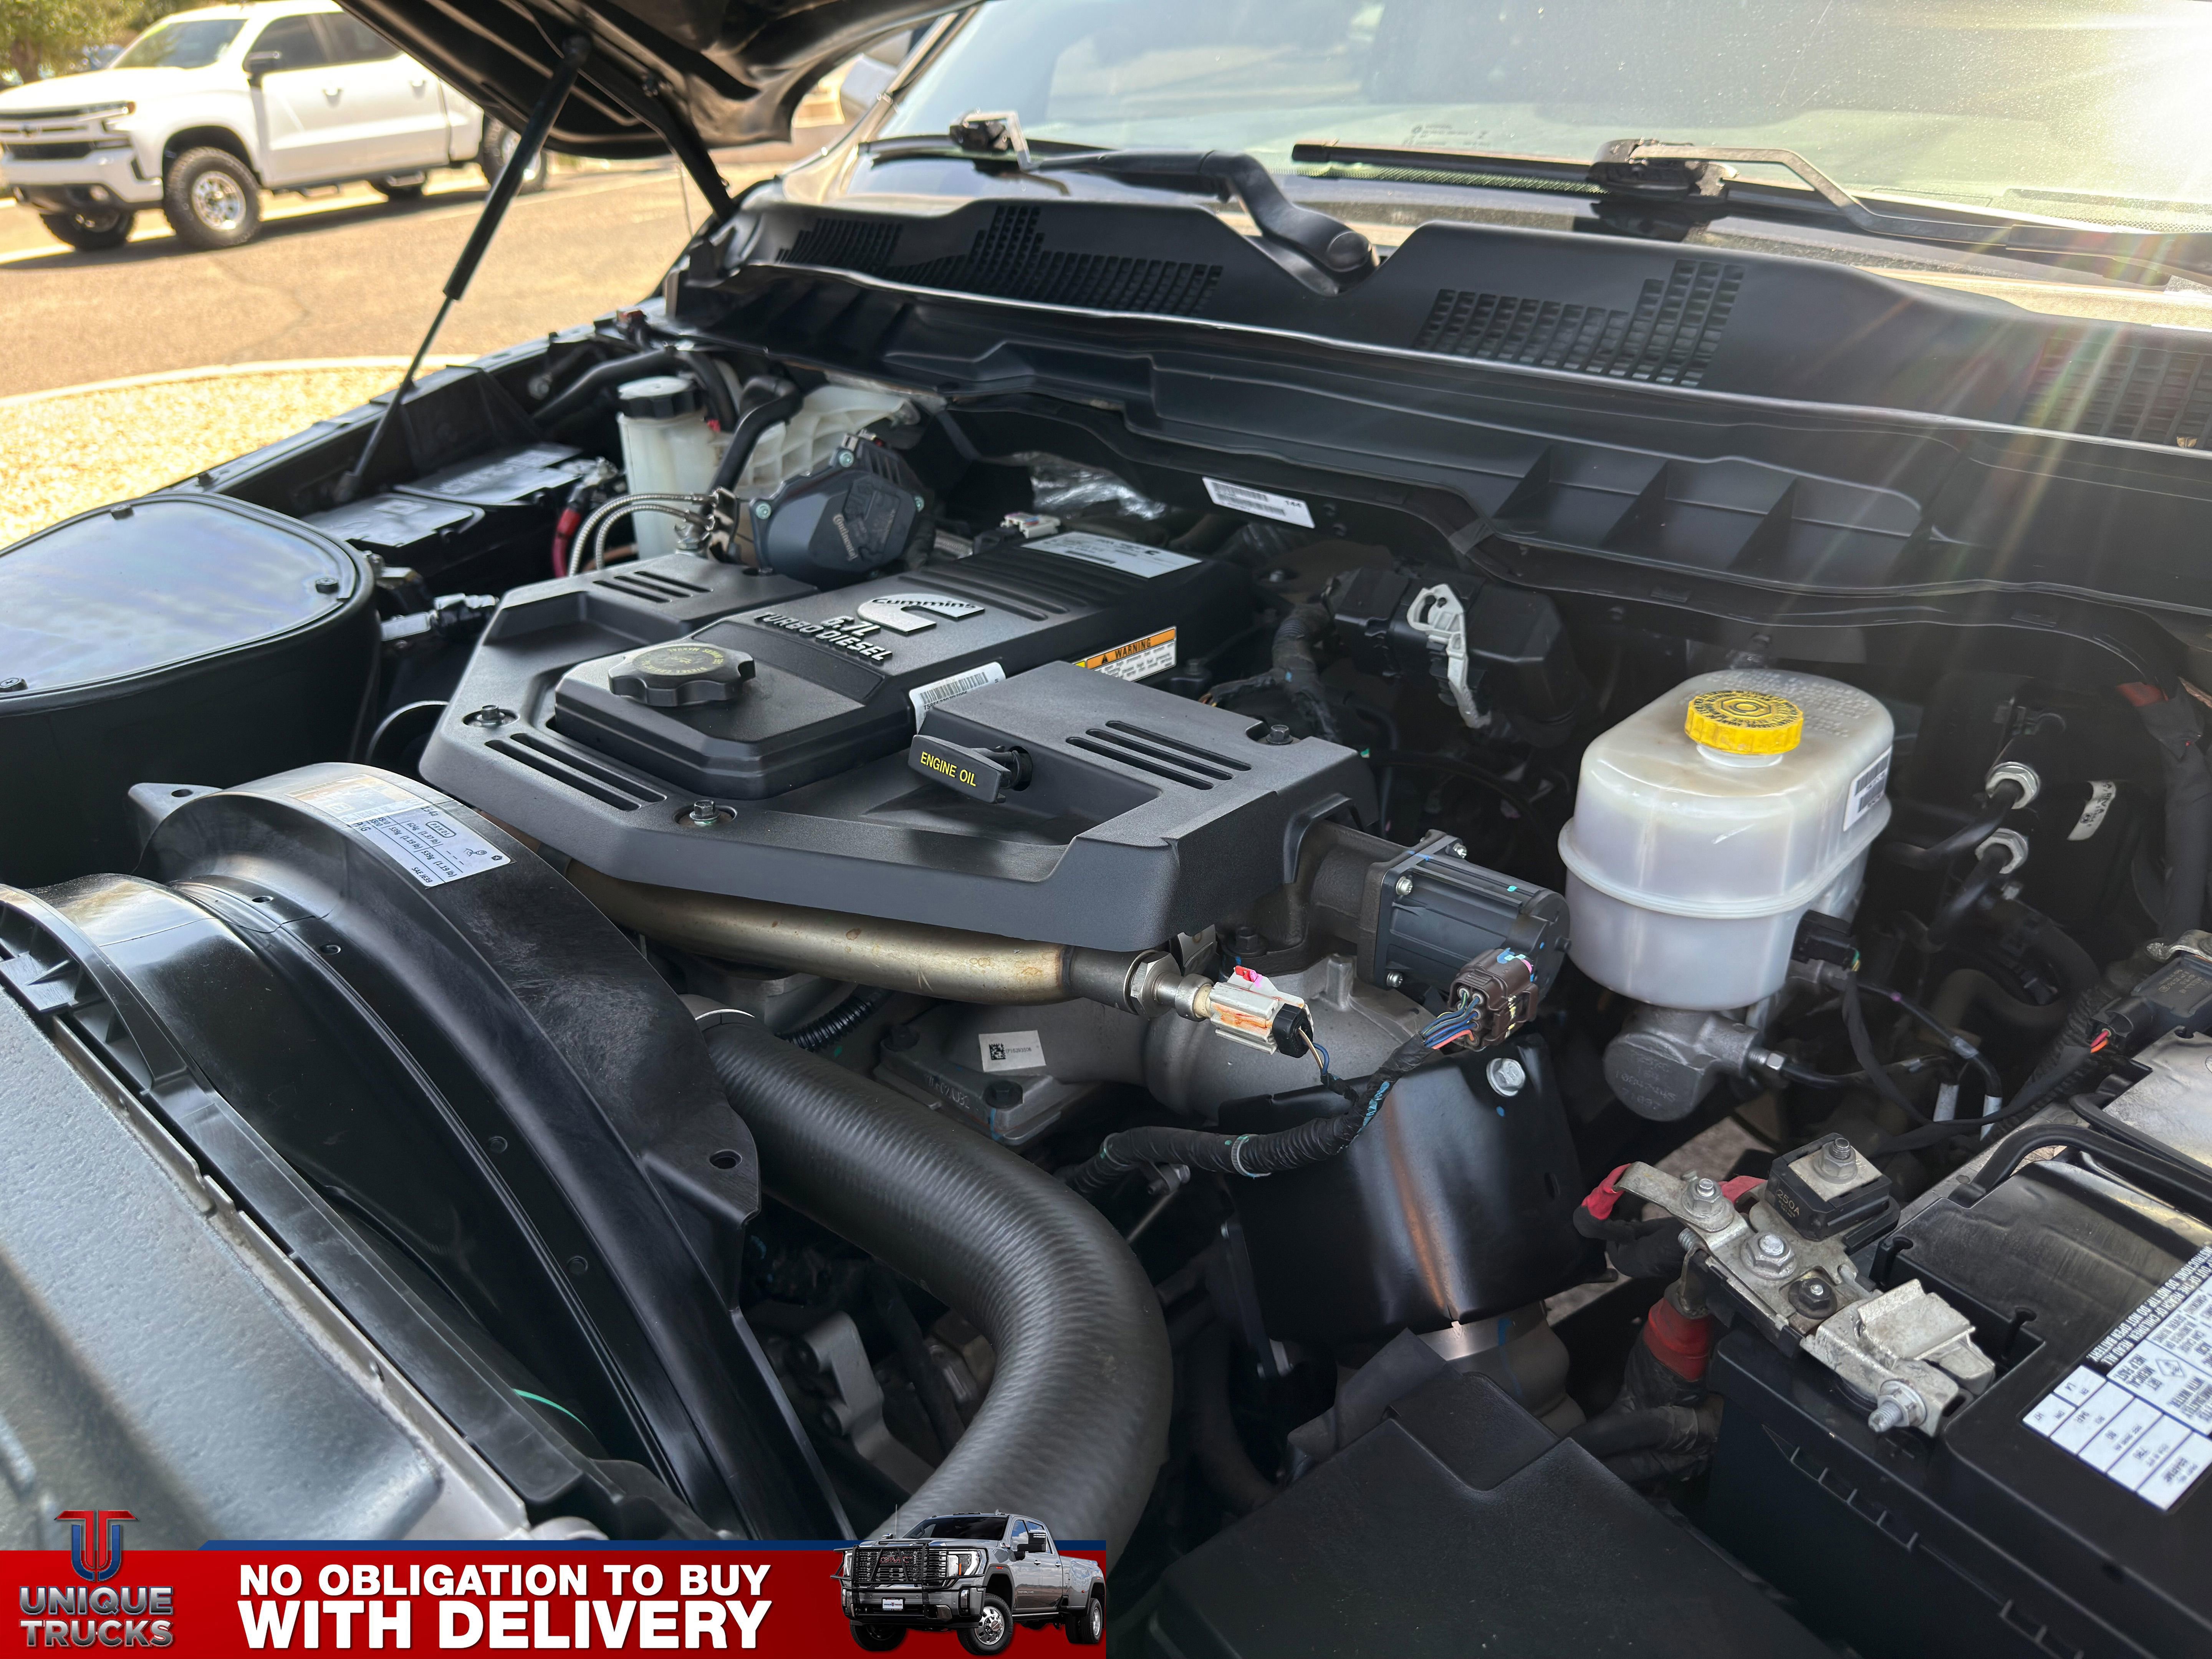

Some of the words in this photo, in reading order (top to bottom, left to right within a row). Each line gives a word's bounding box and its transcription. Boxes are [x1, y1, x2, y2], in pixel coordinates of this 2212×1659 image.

[832, 513, 859, 561] Continental
[821, 616, 881, 636] 6.7L
[754, 612, 825, 635] TURBO
[815, 629, 893, 661] DIESEL
[1115, 638, 1152, 659] WARNING
[921, 751, 957, 778] ENGINE
[959, 769, 977, 787] OIL
[430, 823, 450, 836] PRNDL
[421, 850, 435, 860] 539g
[412, 867, 422, 875] SAE
[1777, 1189, 1799, 1216] 250A
[2164, 1278, 2180, 1290] DO
[2177, 1282, 2194, 1295] THE
[2189, 1275, 2202, 1286] OF
[2154, 1286, 2172, 1300] NOT
[2162, 1291, 2185, 1310] REACH
[2136, 1305, 2152, 1315] DO
[2154, 1306, 2168, 1318] OF
[2125, 1312, 2143, 1327] NOT
[2126, 1313, 2161, 1342] CHILDREN.
[2110, 1323, 2133, 1341] OPEN
[2112, 1339, 2134, 1357] READ
[2100, 1352, 2119, 1365] ALL
[2128, 1354, 2147, 1370] HELP
[2113, 1365, 2135, 1382] FAST.
[2126, 1364, 2156, 1389] MEDICAL
